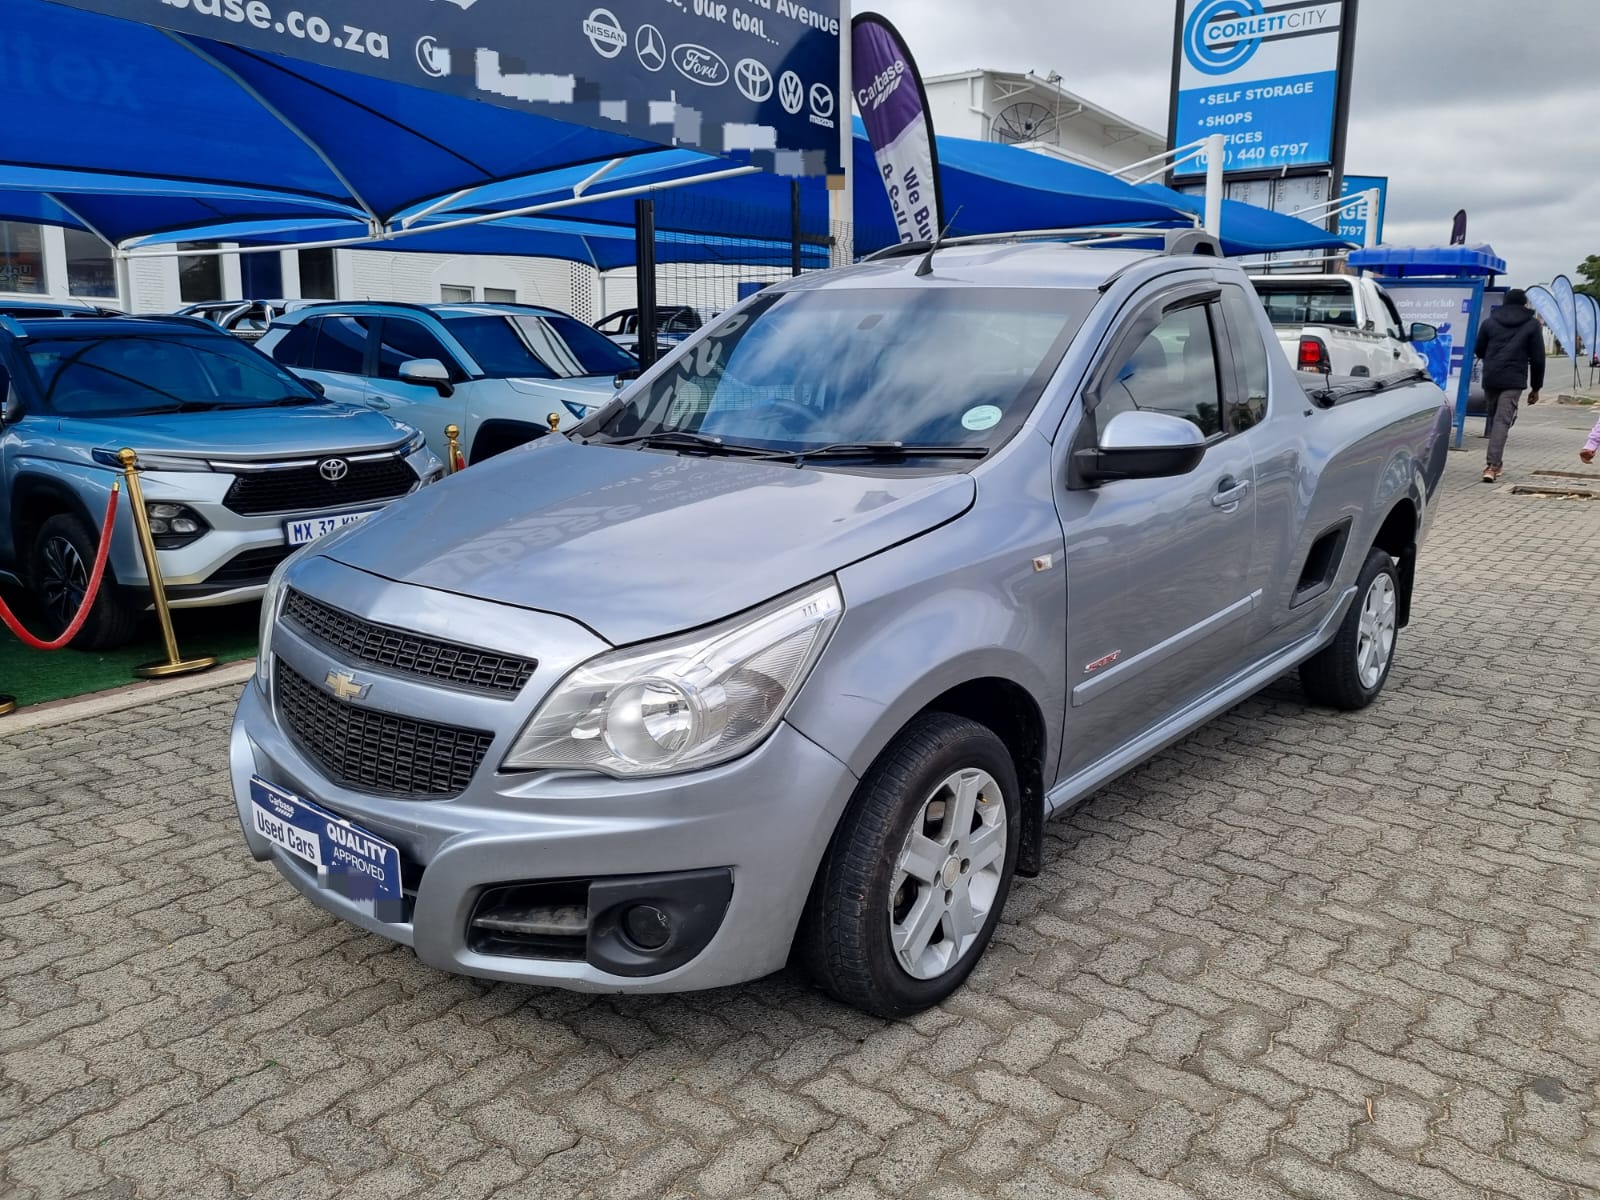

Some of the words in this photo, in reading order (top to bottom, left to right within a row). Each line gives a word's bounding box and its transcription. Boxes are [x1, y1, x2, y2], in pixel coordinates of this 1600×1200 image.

[694, 0, 727, 23] OUR
[776, 0, 839, 36] Avenue
[161, 0, 389, 59] ase.co.za
[586, 24, 625, 43] NISSAN
[682, 49, 719, 79] Ford
[858, 60, 905, 107] Carbase
[1207, 90, 1241, 106] SELF
[1245, 81, 1314, 101] STORAGE
[1206, 111, 1253, 127] SHOPS
[1224, 131, 1263, 145] FICES
[1237, 147, 1265, 161] 440
[1269, 142, 1309, 157] 6797
[904, 166, 920, 205] We
[293, 523, 313, 542] MX
[256, 810, 285, 843] Used
[287, 825, 315, 860] Cars
[326, 823, 387, 865] QUALITY
[333, 847, 385, 881] APPROVED
